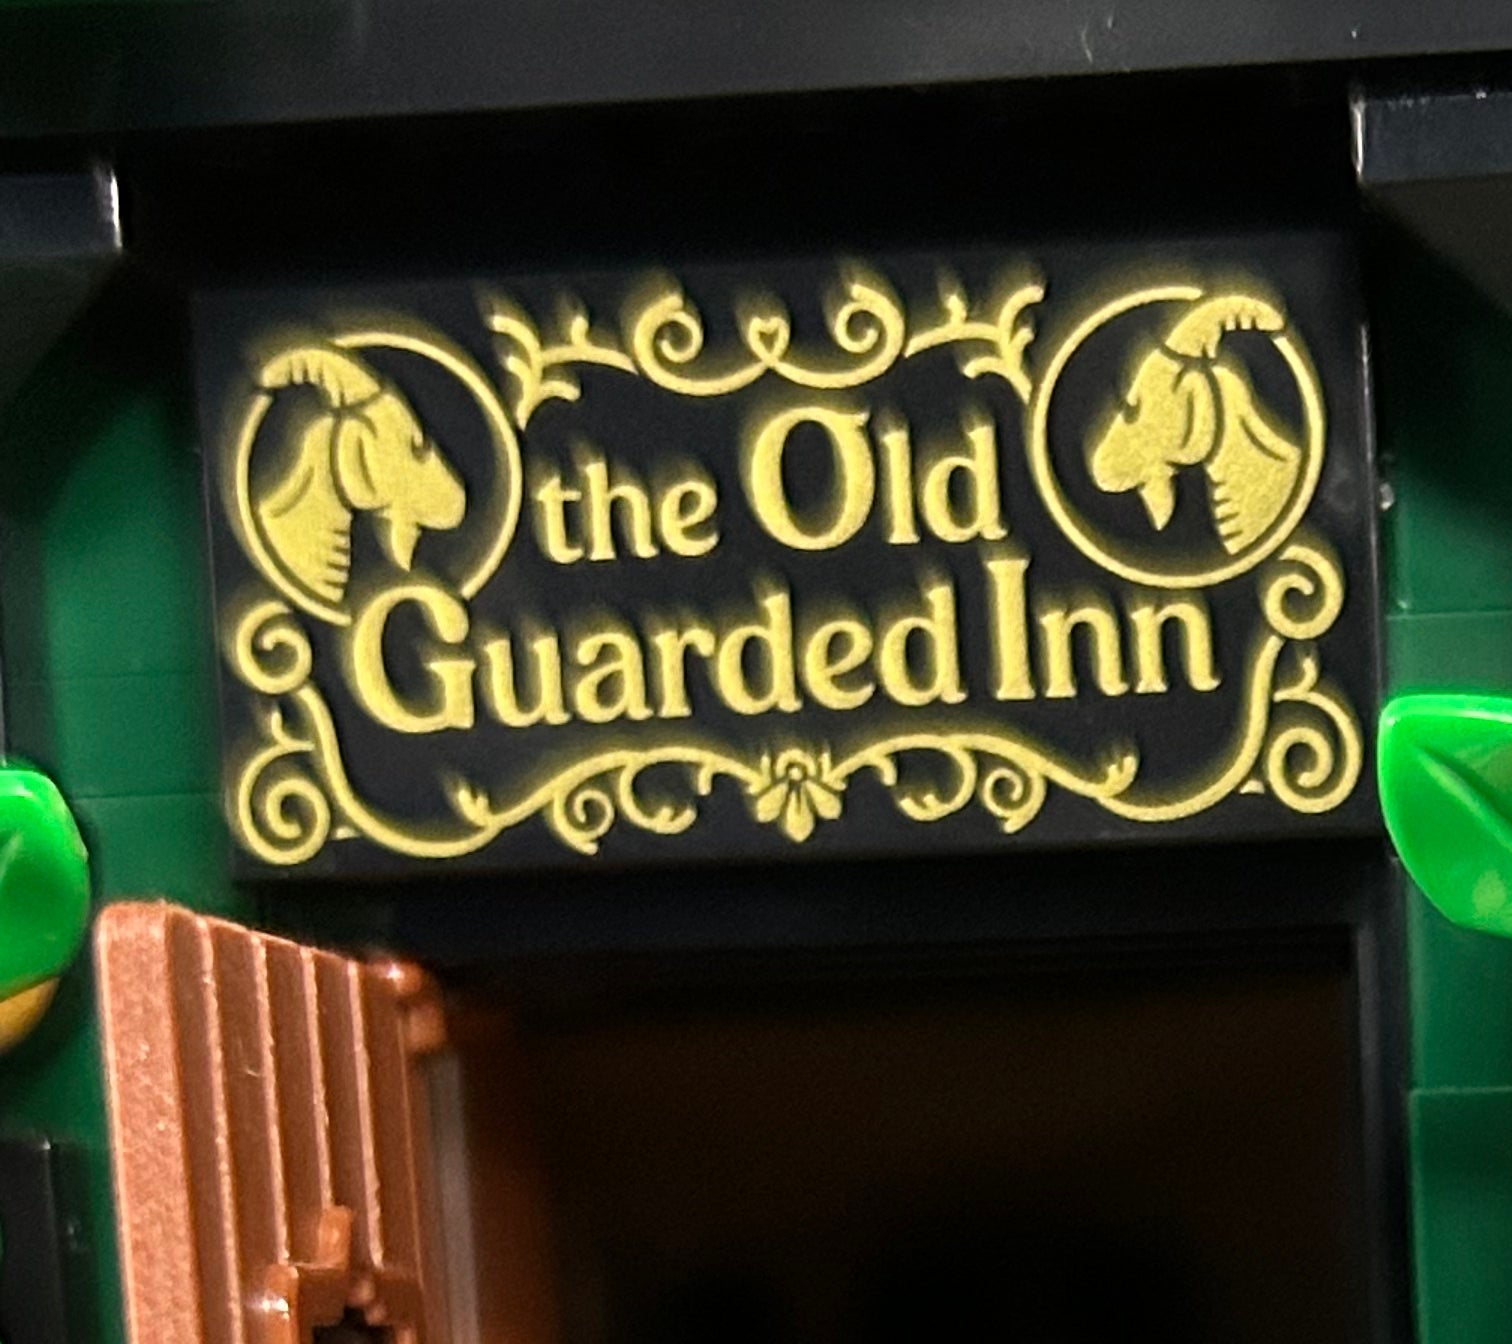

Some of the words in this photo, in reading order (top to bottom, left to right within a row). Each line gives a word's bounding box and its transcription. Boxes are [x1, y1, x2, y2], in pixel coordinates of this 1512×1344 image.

[532, 457, 719, 564] the
[745, 403, 1008, 550] Old
[352, 580, 967, 735] Guarded
[984, 554, 1221, 702] Inn
